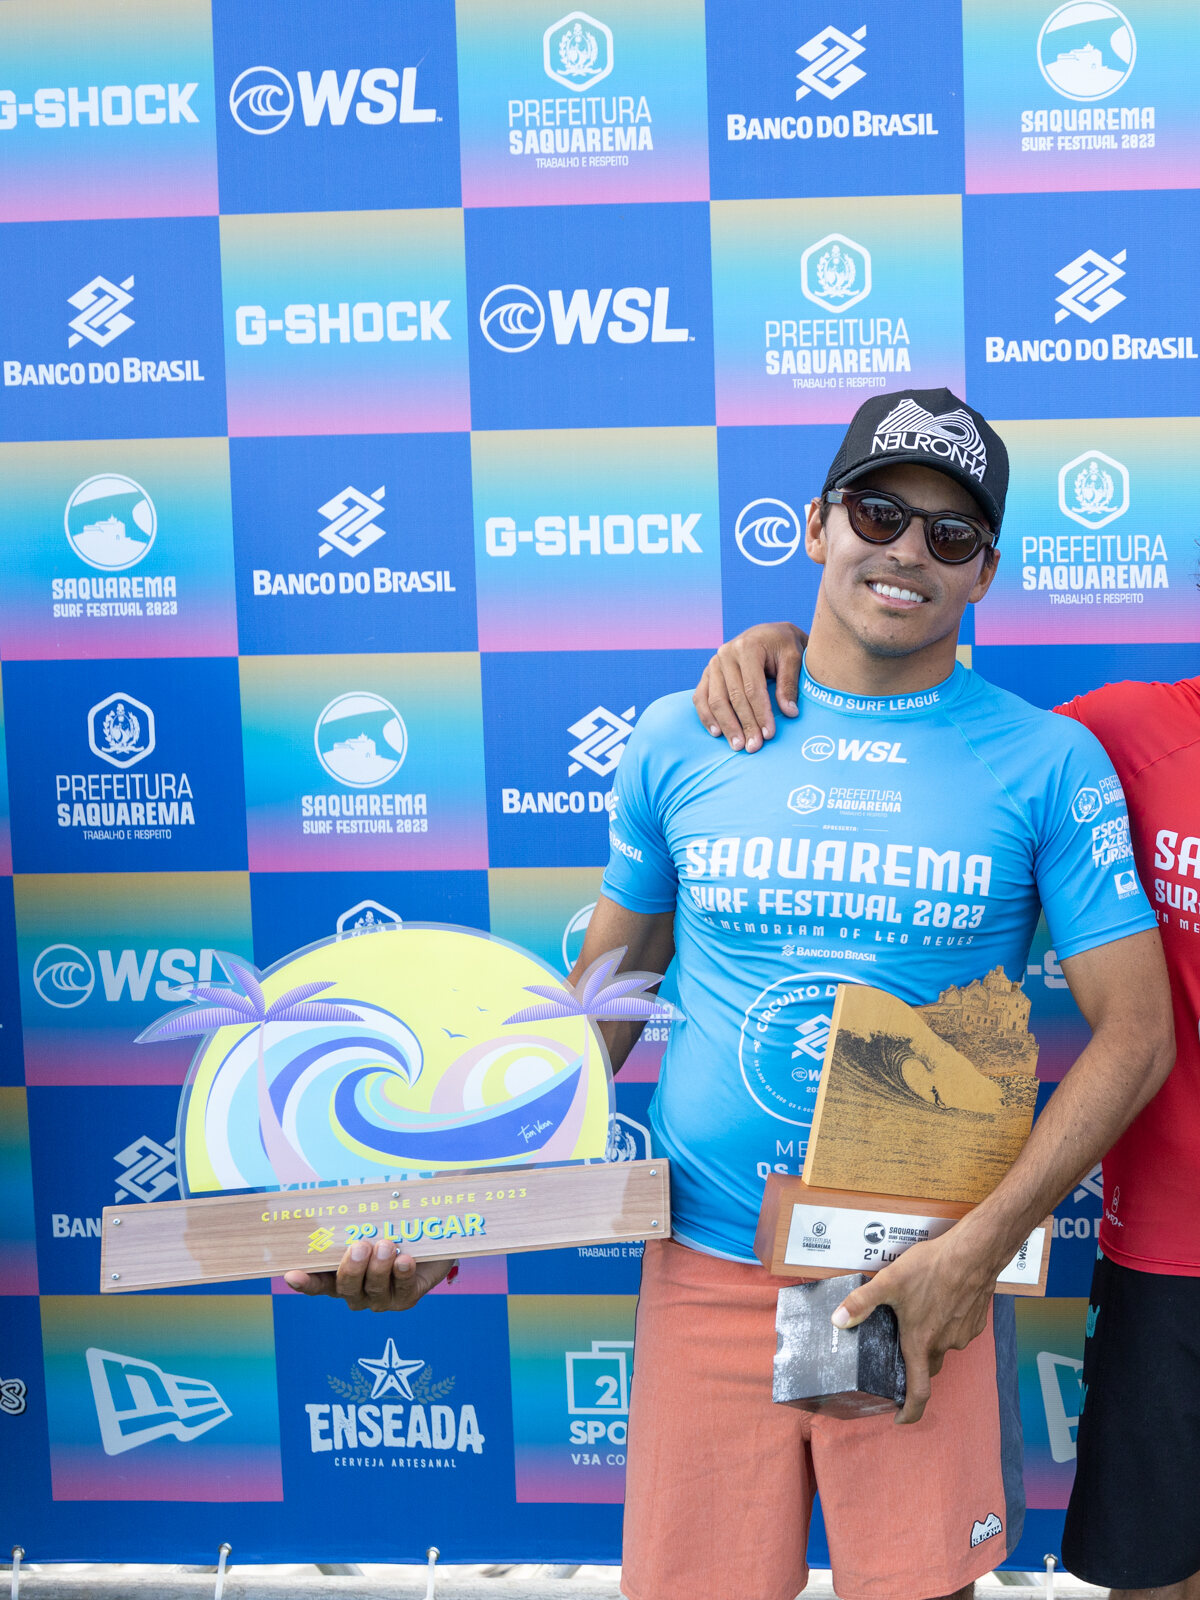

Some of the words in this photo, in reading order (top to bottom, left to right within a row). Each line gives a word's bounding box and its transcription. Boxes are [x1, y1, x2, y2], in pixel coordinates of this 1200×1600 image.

[297, 67, 436, 126] WSL
[509, 96, 652, 127] PREFEITURA
[1022, 107, 1154, 133] SAQUAREMA
[727, 114, 813, 140] BANCO
[817, 115, 849, 138] DO
[853, 111, 938, 136] BRASIL
[510, 126, 653, 155] SAQUAREMA
[1022, 137, 1053, 151] SURF
[1057, 135, 1118, 150] FESTIVAL
[1122, 134, 1155, 149] 2023
[536, 157, 579, 168] TRABALHO
[589, 156, 628, 167] RESPEITO
[236, 300, 451, 345] G-SHOCK
[549, 287, 688, 344] WSL
[766, 318, 910, 347] PREFEITURA
[986, 337, 1071, 362] BANCO
[1076, 339, 1108, 360] DO
[1112, 334, 1198, 360] BRASIL
[4, 361, 85, 386] BANCO
[89, 362, 120, 383] DO
[123, 358, 204, 382] BRASIL
[766, 348, 911, 375] SAQUAREMA
[792, 378, 836, 388] TRABALHO
[847, 377, 886, 387] RESPEITO
[485, 514, 703, 556] G-SHOCK
[1023, 535, 1168, 563] PREFEITURA
[52, 576, 176, 600] SAQUAREMA
[253, 570, 335, 595] BANCO
[339, 572, 370, 594] DO
[374, 568, 456, 593] BRASIL
[1023, 565, 1169, 590] SAQUAREMA
[53, 604, 83, 617] SURF
[87, 603, 143, 617] FESTIVAL
[146, 601, 177, 616] 2023
[1049, 594, 1093, 604] TRABALHO
[1104, 593, 1143, 603] RESPEITO
[803, 678, 842, 707] WORLD
[846, 699, 886, 711] SURF
[889, 691, 940, 710] LEAGUE
[837, 738, 908, 764] WSL
[56, 773, 193, 800] PREFEITURA
[829, 787, 902, 802] PREFEITURA
[58, 802, 195, 826] SAQUAREMA
[302, 794, 427, 817] SAQUAREMA
[502, 789, 584, 813] BANCO
[827, 799, 902, 813] SAQUAREMA
[83, 830, 125, 840] TRABALHO
[134, 829, 171, 839] RESPEITO
[303, 821, 332, 834] SURF
[336, 820, 393, 833] FESTIVAL
[396, 819, 428, 833] 2023
[684, 836, 993, 897] SAQUAREMA
[689, 885, 748, 914] SURF
[758, 888, 902, 924] FESTIVAL
[912, 900, 986, 930] 2023
[720, 919, 825, 937] MEMORIAM
[839, 927, 861, 939] OF
[875, 930, 909, 945] LEO
[922, 935, 974, 947] NEVES
[797, 946, 830, 959] BANCO
[830, 951, 844, 960] DO
[844, 951, 878, 962] BRASIL
[756, 985, 820, 1033] CIRCUITO
[261, 1205, 348, 1222] CIRCUITO
[359, 1202, 379, 1213] BB
[390, 1199, 410, 1210] DE
[420, 1193, 476, 1207] SURFE
[485, 1188, 528, 1201] 2023
[383, 1213, 485, 1243] LUGAR
[889, 1227, 929, 1237] SAQUAREMA
[578, 1247, 619, 1258] TRABALHO
[863, 1248, 879, 1260] 2º
[305, 1404, 485, 1454] ENSEADA
[335, 1457, 384, 1467] CERVEJA
[392, 1458, 456, 1468] ARTESANAL
[572, 1454, 601, 1465] V3A
